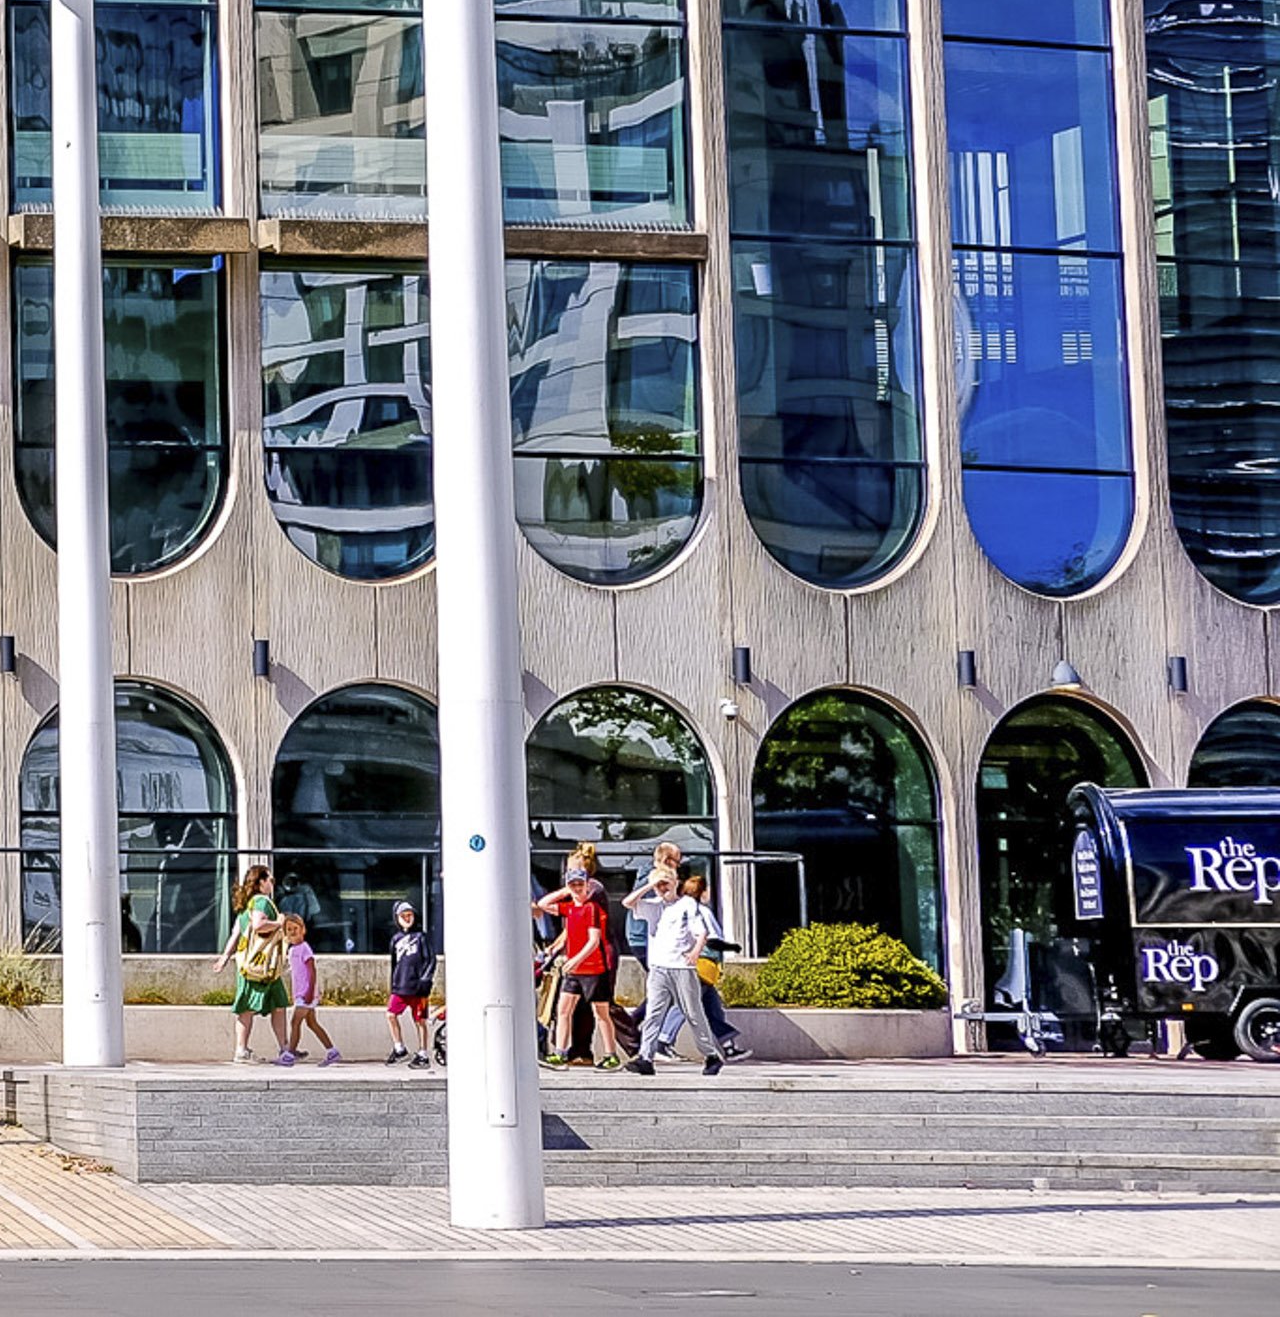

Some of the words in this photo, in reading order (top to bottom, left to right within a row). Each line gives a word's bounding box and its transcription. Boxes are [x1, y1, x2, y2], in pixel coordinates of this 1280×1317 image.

[1219, 836, 1257, 858] the
[1184, 846, 1280, 905] Rep
[1167, 939, 1195, 957] the
[1142, 948, 1219, 992] Rep
